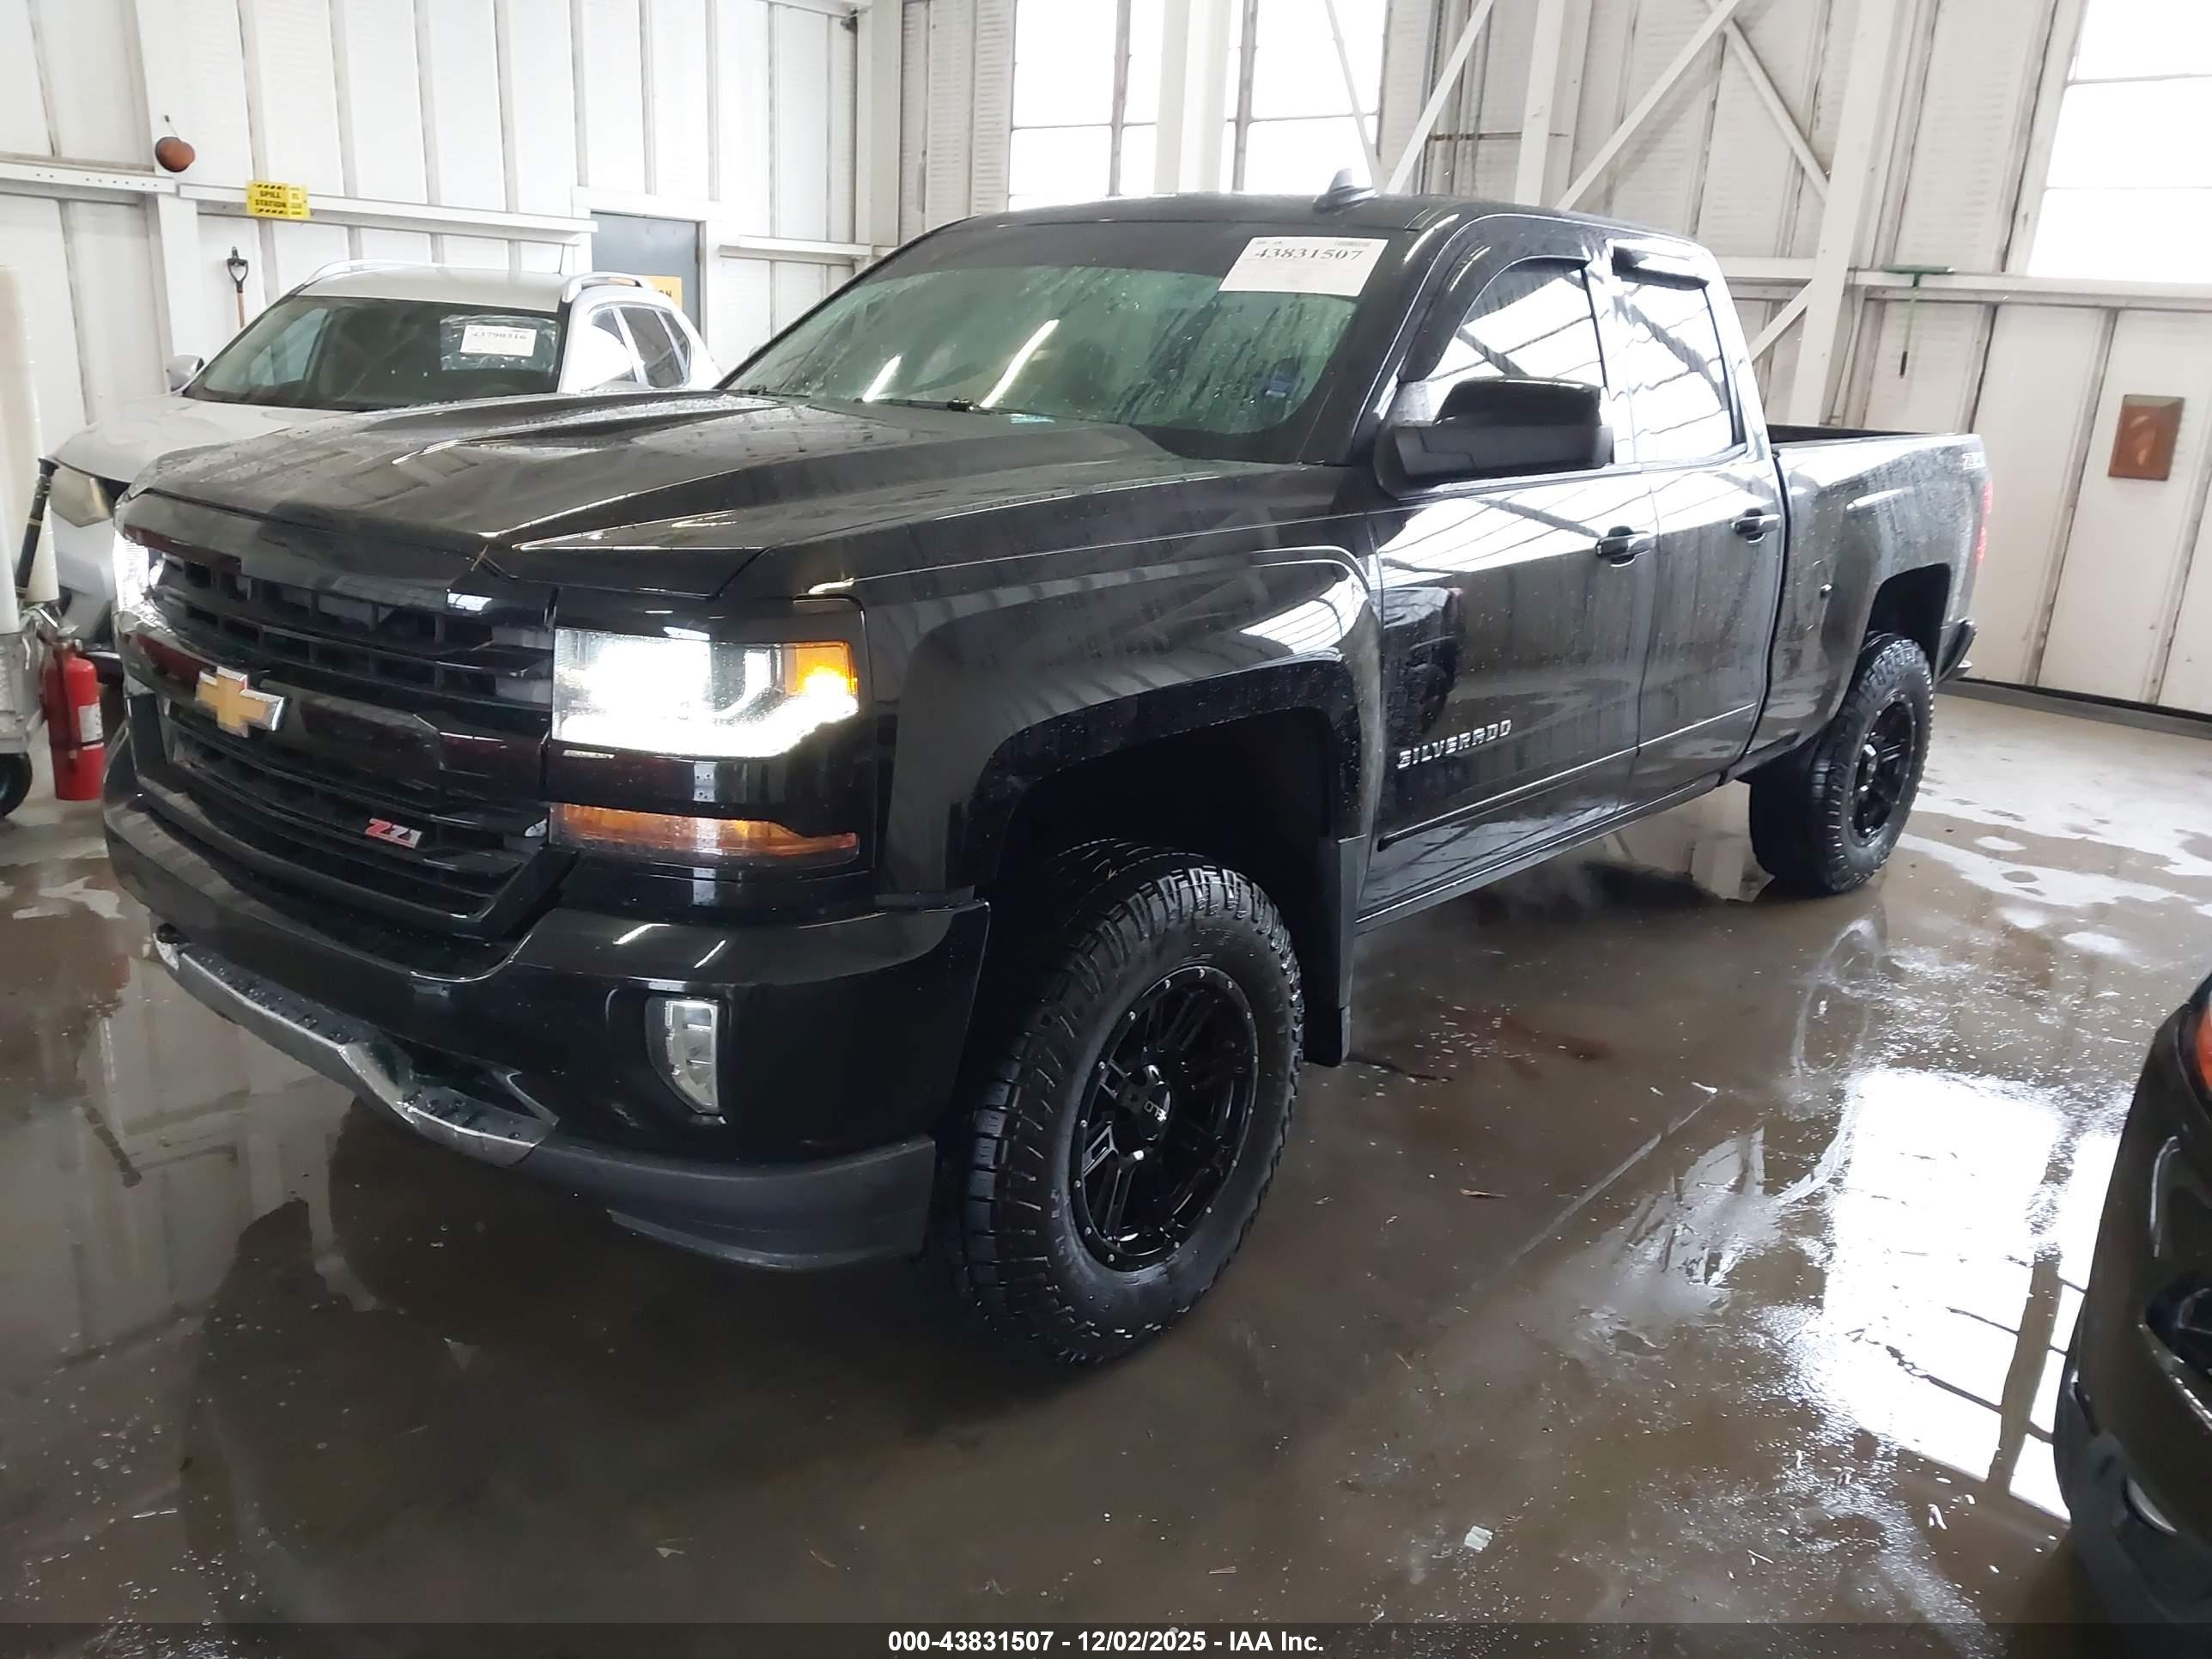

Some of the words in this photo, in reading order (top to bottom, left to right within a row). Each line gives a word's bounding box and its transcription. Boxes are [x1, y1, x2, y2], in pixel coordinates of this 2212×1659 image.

[259, 190, 282, 199] SPILL
[255, 198, 287, 209] STATION
[1255, 247, 1364, 261] 43831507
[1396, 719, 1512, 769] SILVERADO
[365, 817, 422, 849] Z71
